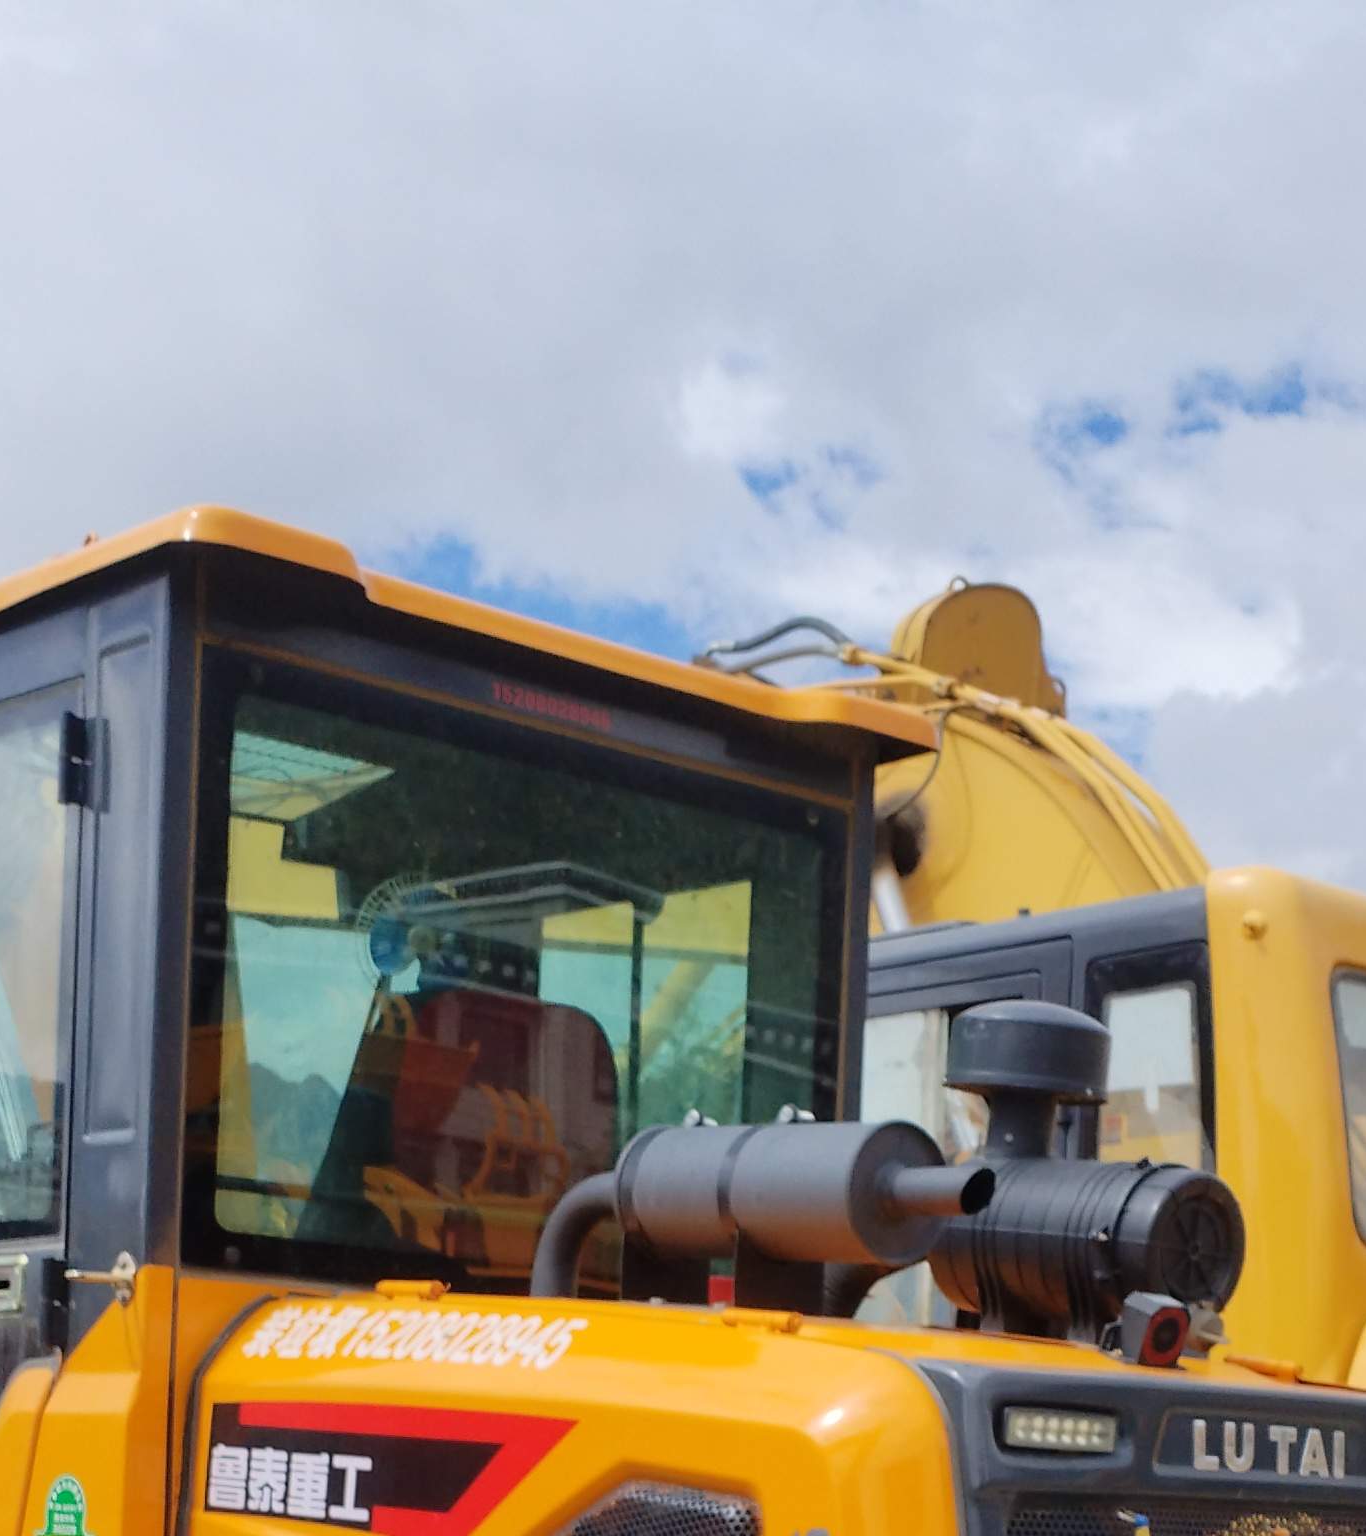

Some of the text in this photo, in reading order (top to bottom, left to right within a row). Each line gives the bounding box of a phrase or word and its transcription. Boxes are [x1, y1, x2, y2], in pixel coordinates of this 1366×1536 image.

[208, 1443, 373, 1523] 鲁泰重工
[1192, 1418, 1345, 1480] LU TAI
